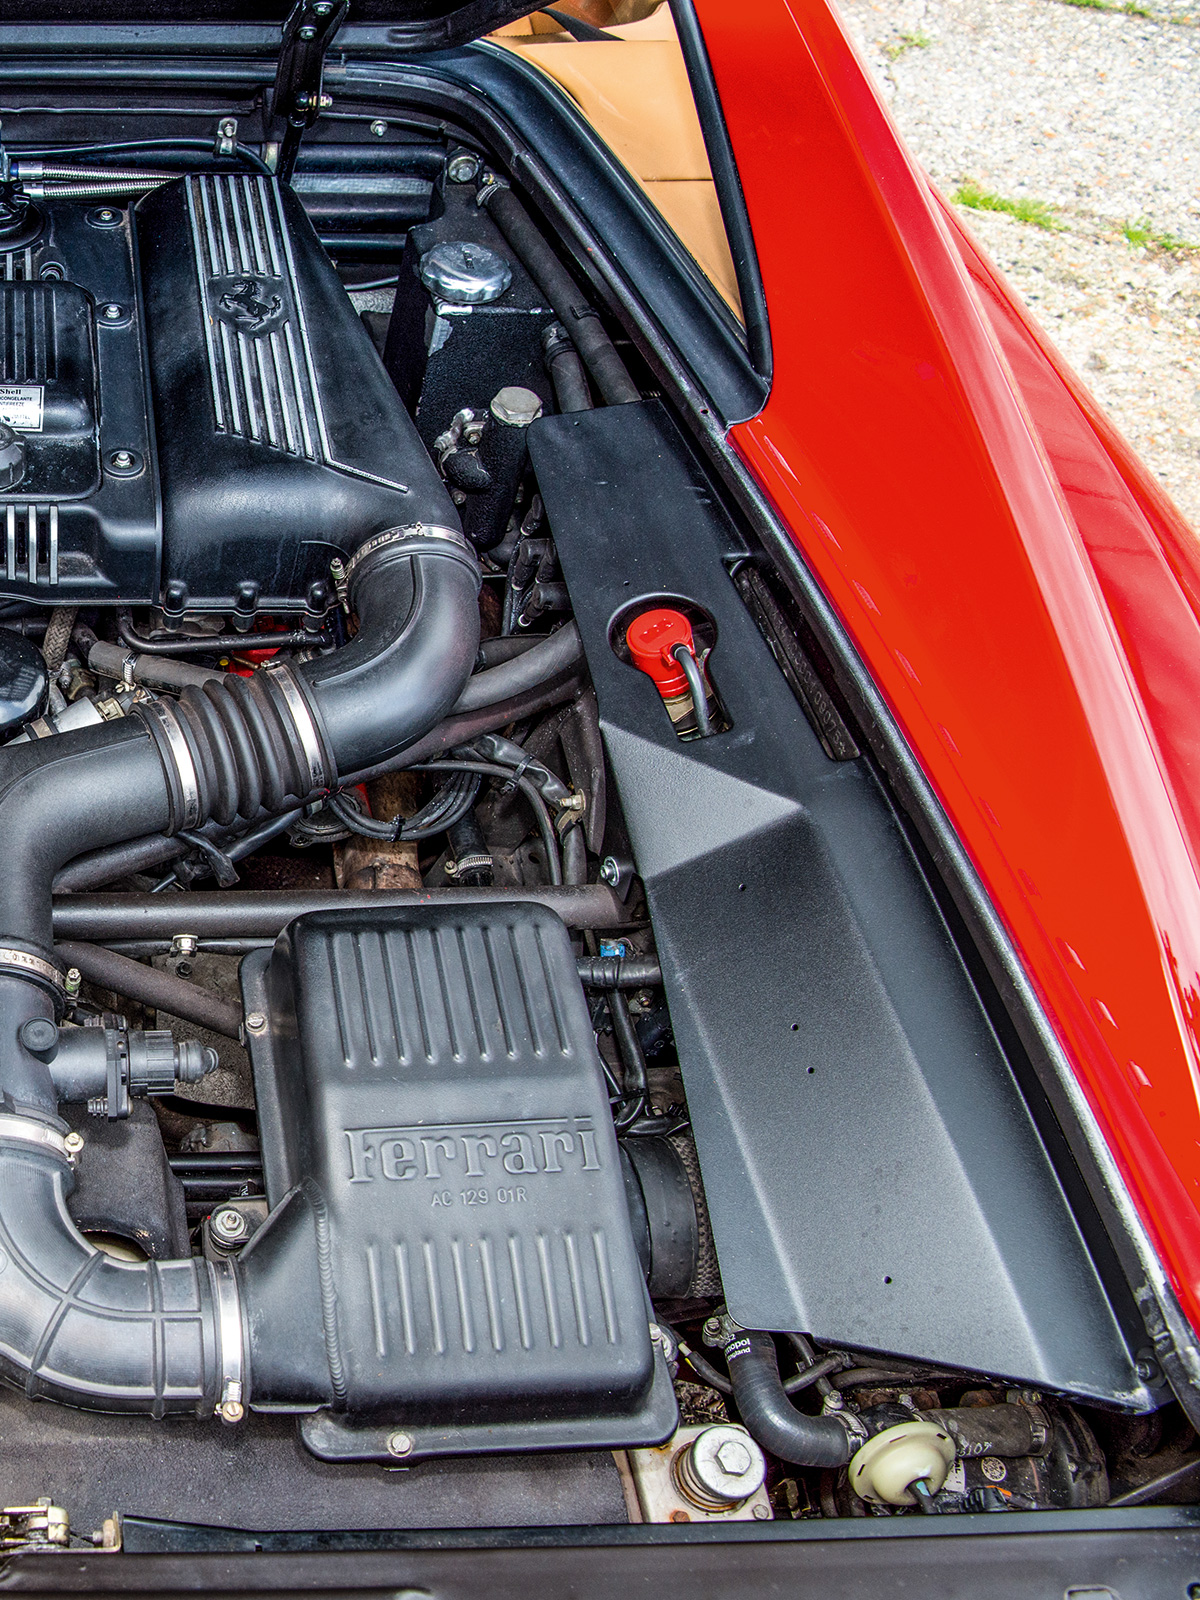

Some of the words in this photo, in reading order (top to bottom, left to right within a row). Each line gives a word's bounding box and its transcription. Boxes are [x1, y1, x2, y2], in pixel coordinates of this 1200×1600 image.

[343, 1116, 601, 1183] Ferrari
[430, 1191, 453, 1207] AC
[459, 1188, 489, 1205] 129
